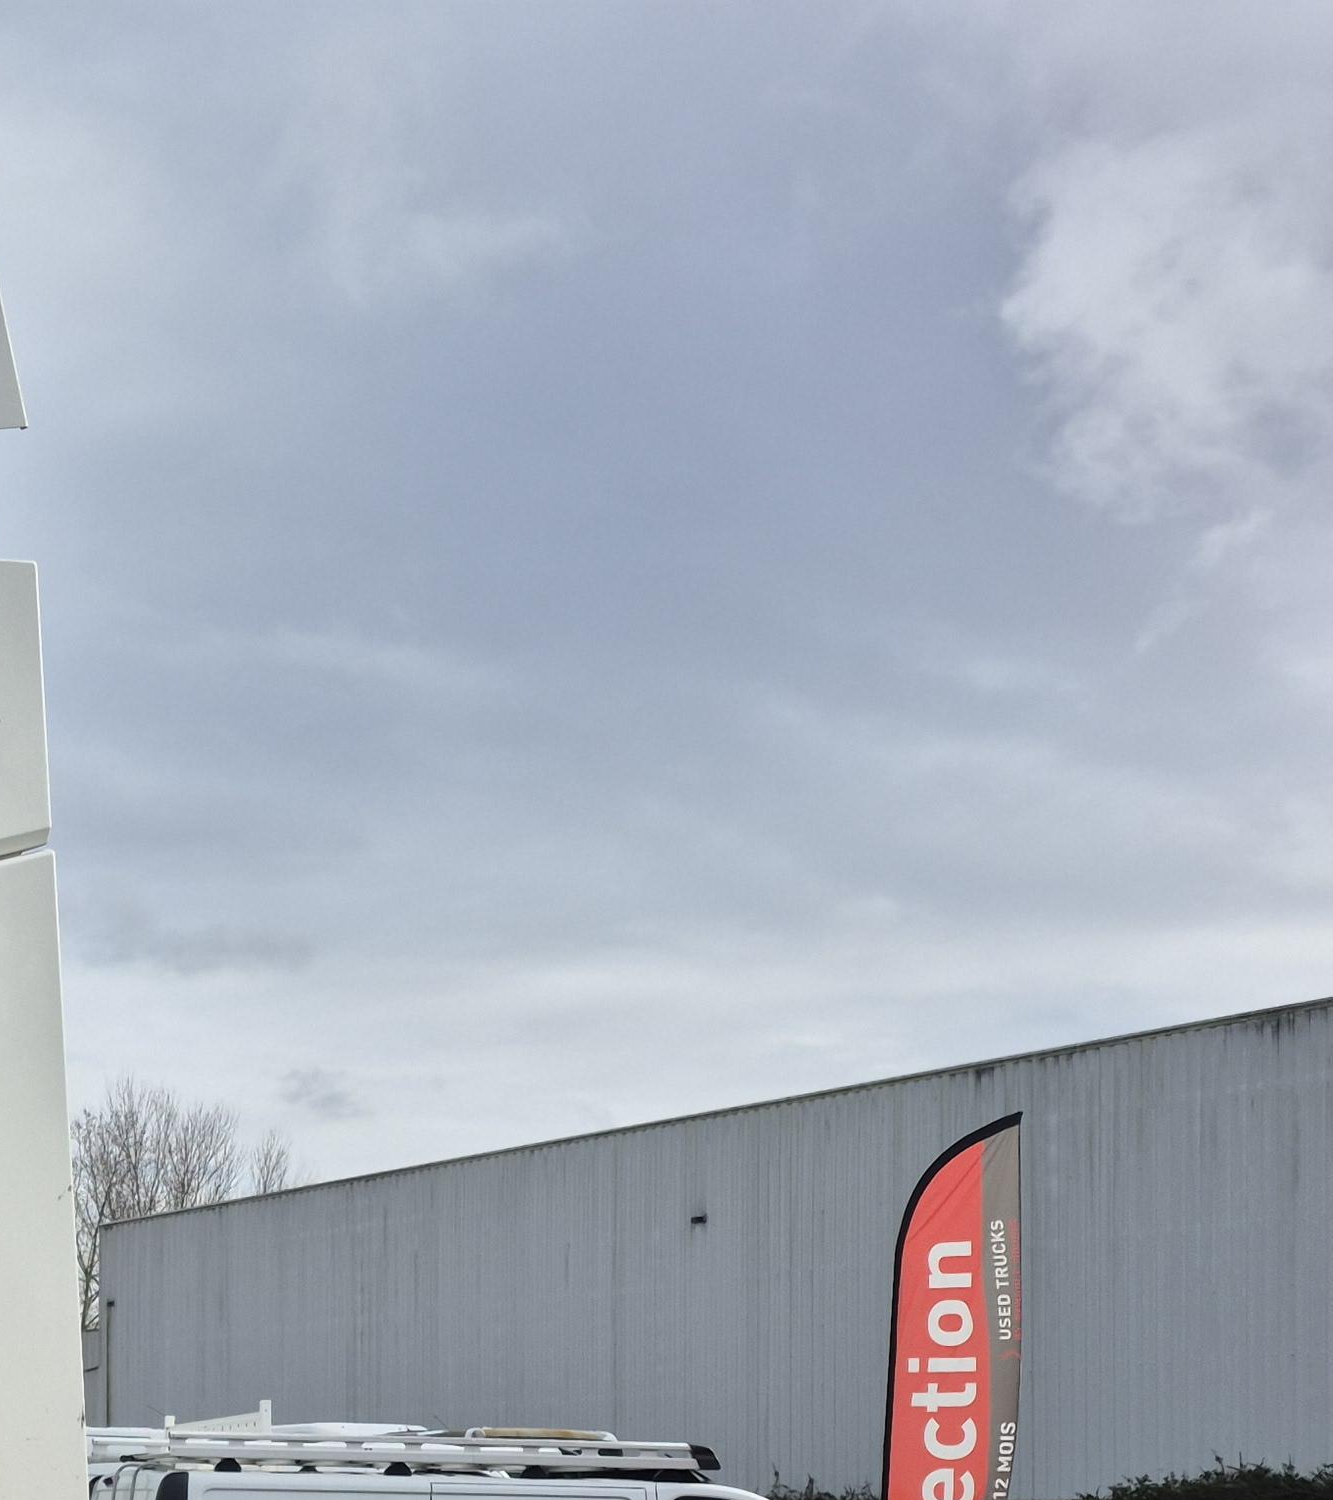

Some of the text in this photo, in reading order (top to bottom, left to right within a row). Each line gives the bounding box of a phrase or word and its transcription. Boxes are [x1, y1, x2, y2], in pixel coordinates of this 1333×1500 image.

[990, 1219, 1012, 1341] USED TRUCKS
[996, 1421, 1017, 1474] MOIS
[992, 1478, 1009, 1500] 12
